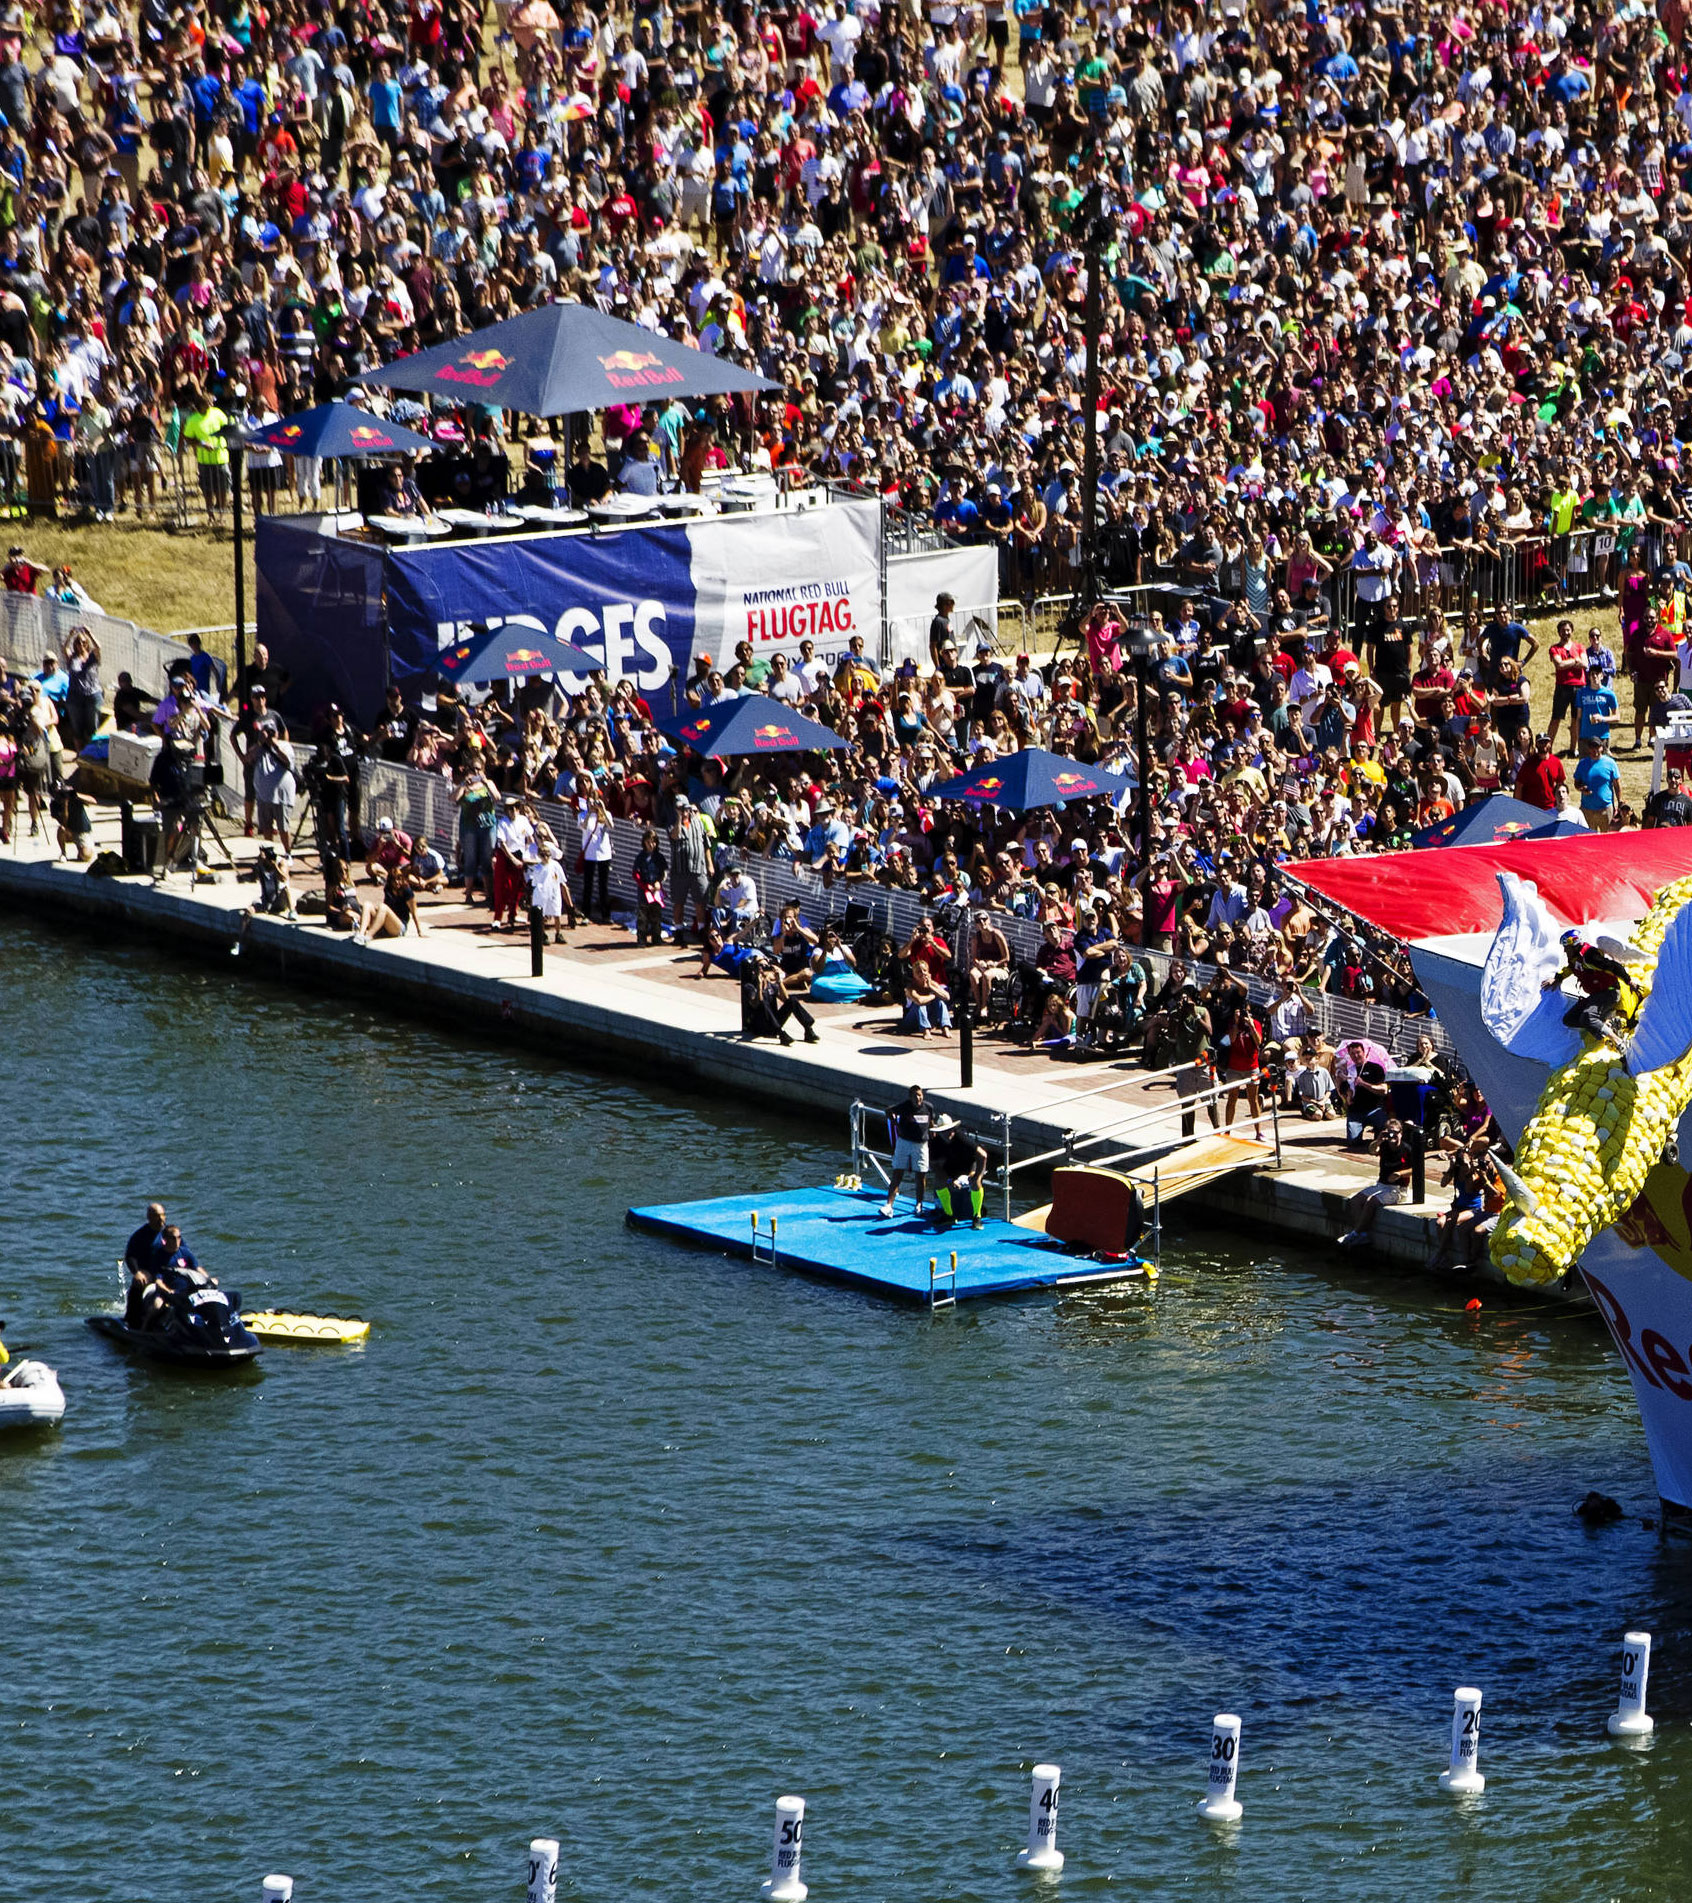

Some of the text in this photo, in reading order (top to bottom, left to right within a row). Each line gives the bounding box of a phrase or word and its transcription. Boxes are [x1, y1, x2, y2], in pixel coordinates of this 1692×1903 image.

[605, 366, 685, 388] Red Bull
[1599, 536, 1612, 550] 10
[743, 580, 851, 606] NATIONAL RED BULL
[747, 598, 857, 643] FLUGTAG.
[437, 600, 673, 705] GES
[1623, 1652, 1639, 1677] 0'
[1211, 1734, 1238, 1762] 30'
